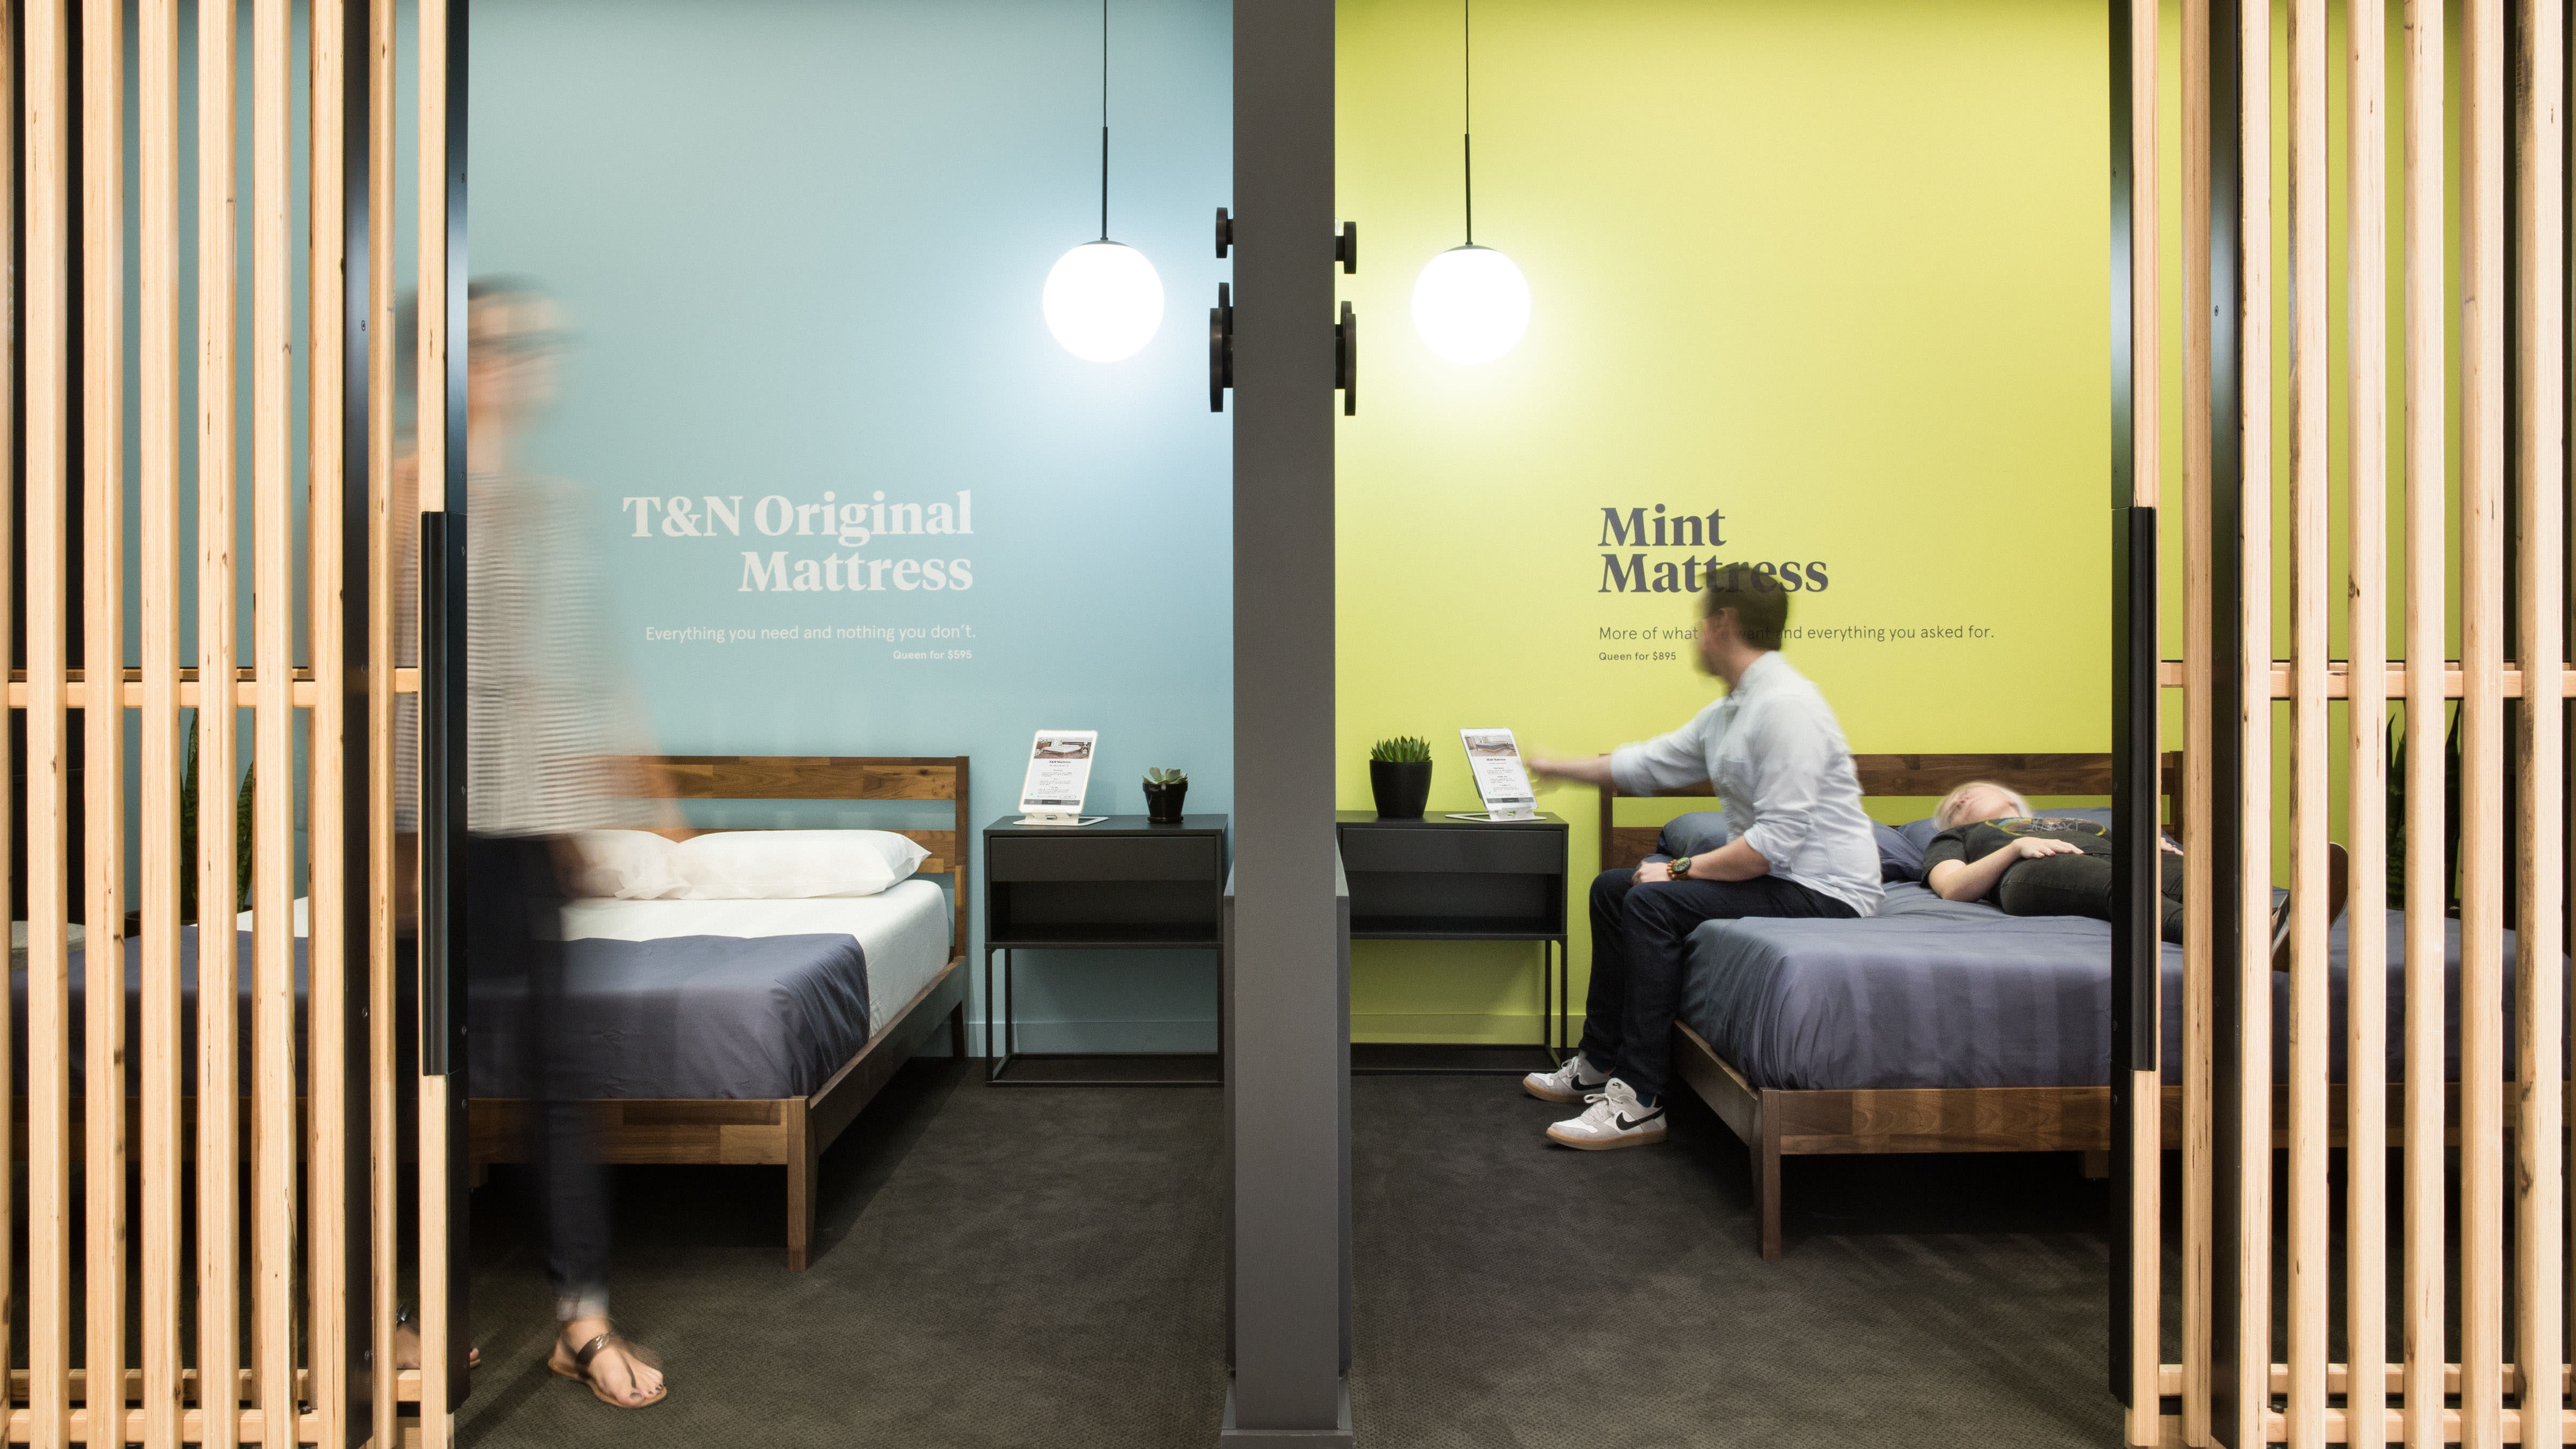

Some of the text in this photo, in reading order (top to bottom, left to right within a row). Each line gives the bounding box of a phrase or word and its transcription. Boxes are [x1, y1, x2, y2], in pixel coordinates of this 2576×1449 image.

[623, 489, 974, 547] T&N Original
[1597, 503, 1728, 547] Mint
[738, 551, 974, 592] Mattress
[1598, 553, 1829, 593] Mattress
[646, 625, 976, 643] Everything you need and nothing you don't.
[1599, 626, 1637, 640] More
[1642, 626, 1658, 640] of
[1662, 626, 1699, 640] what
[1807, 625, 1885, 642] everything
[1889, 628, 1915, 642] you
[1920, 625, 1963, 639] asked
[1968, 625, 1995, 639] for.
[892, 649, 972, 660] Queen for $595
[1598, 651, 1677, 661] Queen for $895
